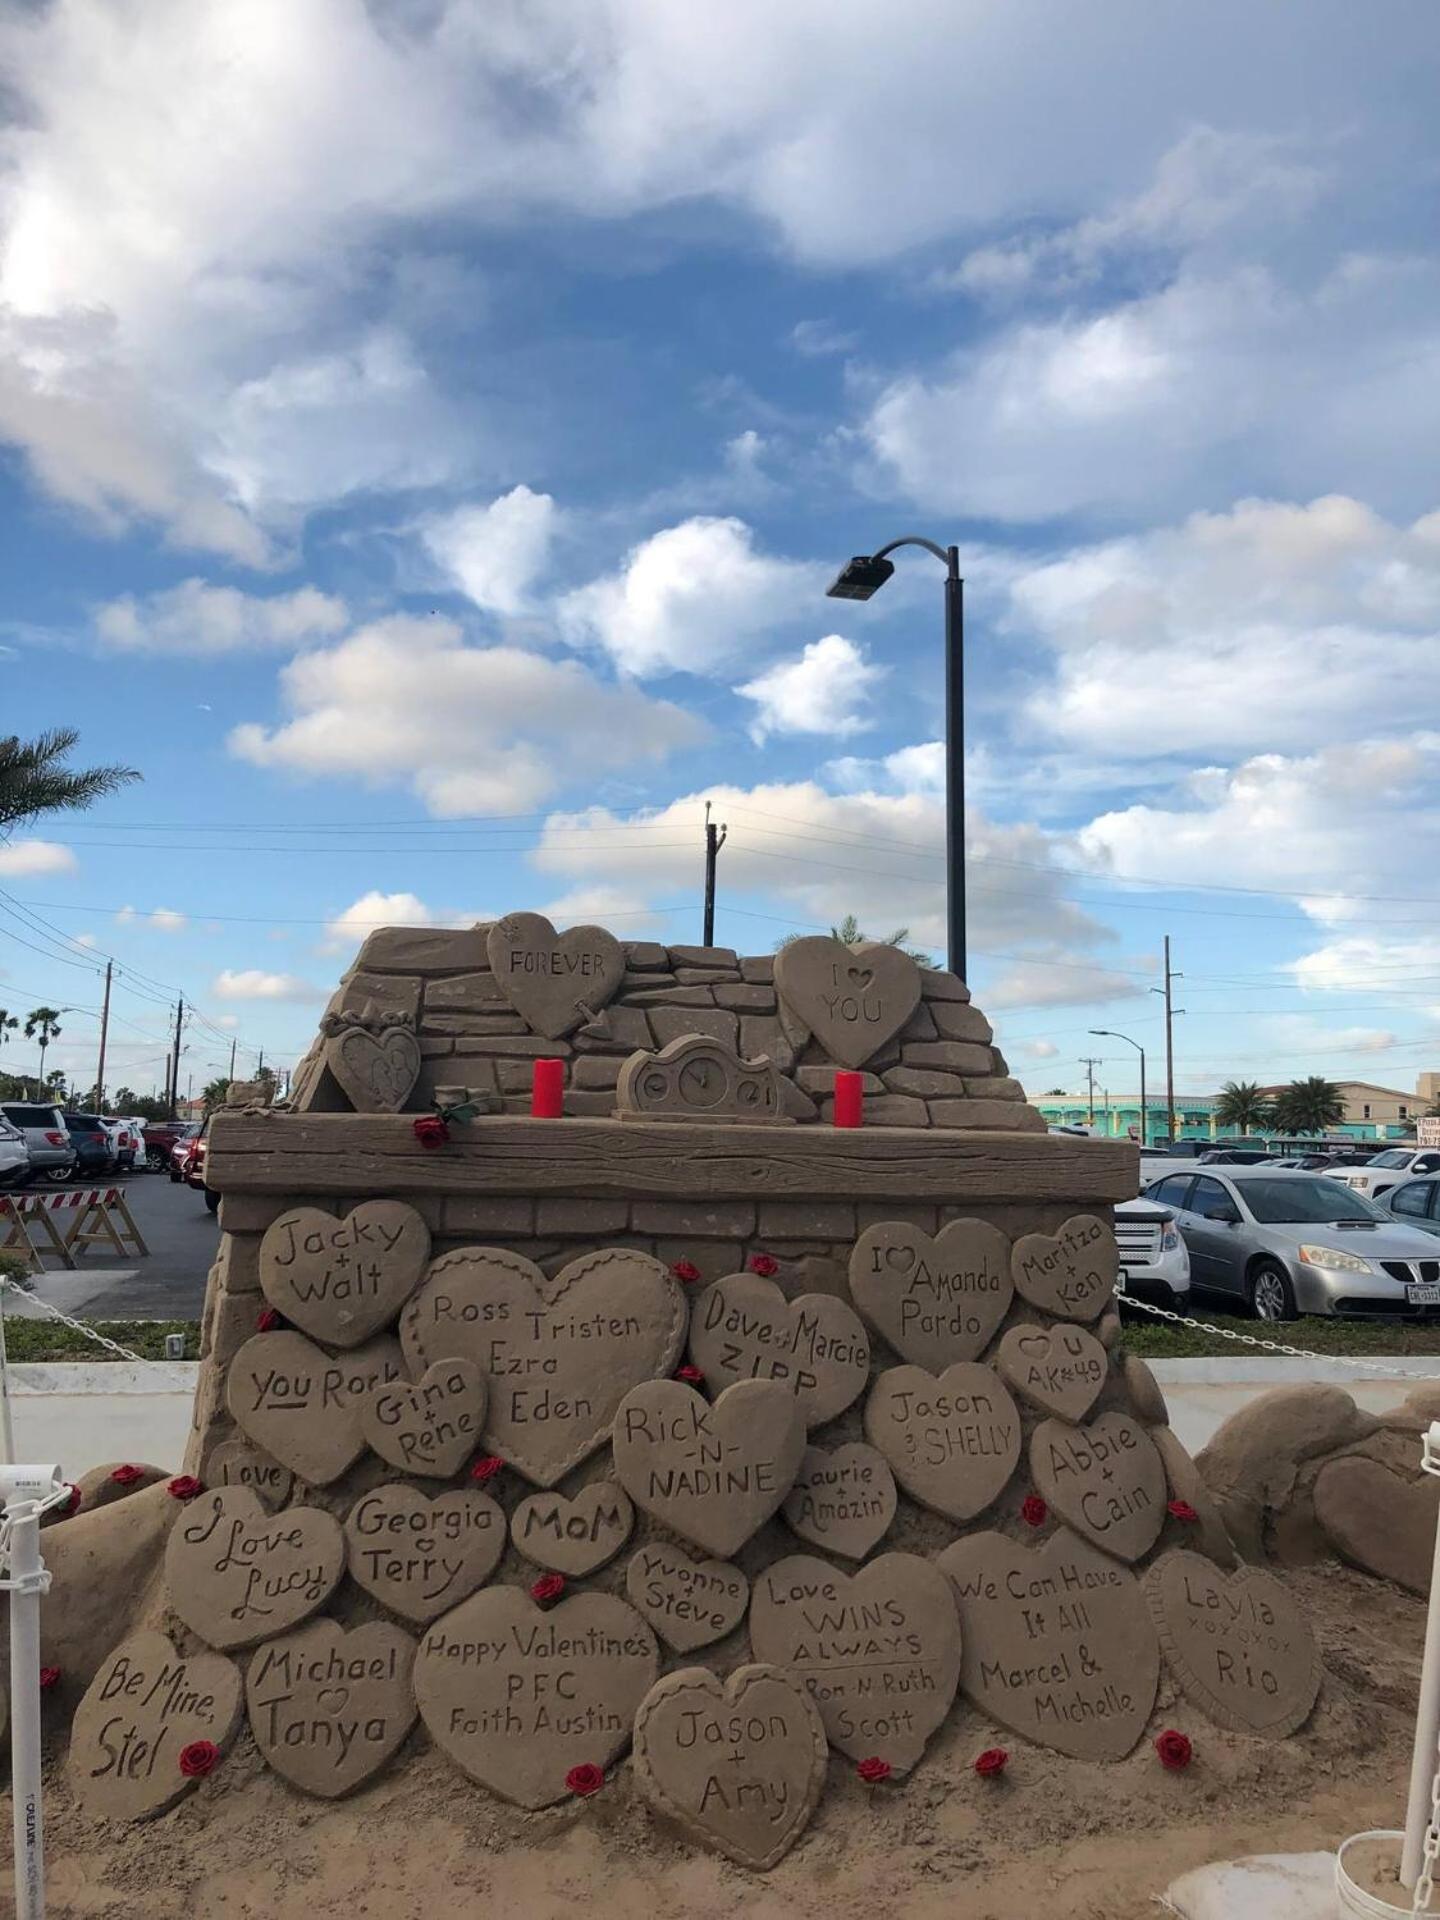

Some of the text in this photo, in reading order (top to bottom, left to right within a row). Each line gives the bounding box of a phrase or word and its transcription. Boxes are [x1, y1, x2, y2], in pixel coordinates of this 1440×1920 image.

[510, 950, 606, 977] FOREVER
[832, 963, 840, 986] I
[822, 997, 882, 1023] YOU
[275, 1217, 403, 1265] Jacky
[1021, 1223, 1103, 1283] Maritza
[336, 1254, 350, 1268] +
[871, 1247, 1000, 1300] I Amanda
[1065, 1265, 1077, 1277] +
[290, 1264, 382, 1301] Walt
[1056, 1270, 1103, 1312] Ken
[434, 1296, 640, 1340] Ross Tristen
[705, 1289, 771, 1344] Dave
[791, 1311, 867, 1368] Marcie
[901, 1299, 981, 1337] Pardo
[490, 1341, 558, 1375] Ezra
[1063, 1337, 1082, 1356] U
[720, 1343, 817, 1396] ZIPP
[375, 1372, 467, 1425] Gina
[424, 1410, 437, 1425] +
[511, 1390, 591, 1424] Eden
[890, 1391, 994, 1423] Jason
[397, 1413, 475, 1464] Rene
[625, 1400, 713, 1443] Rick
[925, 1425, 1011, 1465] SHELLY
[1049, 1426, 1137, 1483] Abbie
[650, 1462, 776, 1498] NADINE
[836, 1488, 847, 1499] +
[1102, 1467, 1114, 1484] +
[184, 1496, 224, 1544] I
[356, 1498, 492, 1539] Georgia
[1080, 1485, 1152, 1533] Cain
[214, 1519, 303, 1572] Love
[231, 1565, 327, 1620] Lucy
[362, 1549, 464, 1600] Terry
[643, 1554, 739, 1598] Yvonne
[684, 1586, 695, 1598] +
[768, 1578, 837, 1604] Love
[951, 1564, 1122, 1599] We Can Have
[646, 1582, 725, 1630] Steve
[803, 1600, 906, 1634] WINS
[1184, 1576, 1274, 1625] Layla
[1022, 1602, 1092, 1639] It All
[426, 1634, 506, 1665] Happy
[793, 1635, 922, 1662] ALWAYS
[980, 1644, 1102, 1689] Marcel &
[100, 1657, 144, 1700] Be
[254, 1648, 395, 1689] Michael
[507, 1671, 576, 1701] PFC
[883, 1668, 936, 1695] Ruth
[1217, 1650, 1278, 1694] Rio
[450, 1704, 622, 1735] Faith Austin
[1035, 1685, 1135, 1723] Michelle
[258, 1695, 386, 1768] Tanya
[676, 1710, 788, 1748] Jason
[838, 1709, 913, 1738] Scott
[727, 1750, 746, 1766] +
[700, 1775, 788, 1825] Amy
